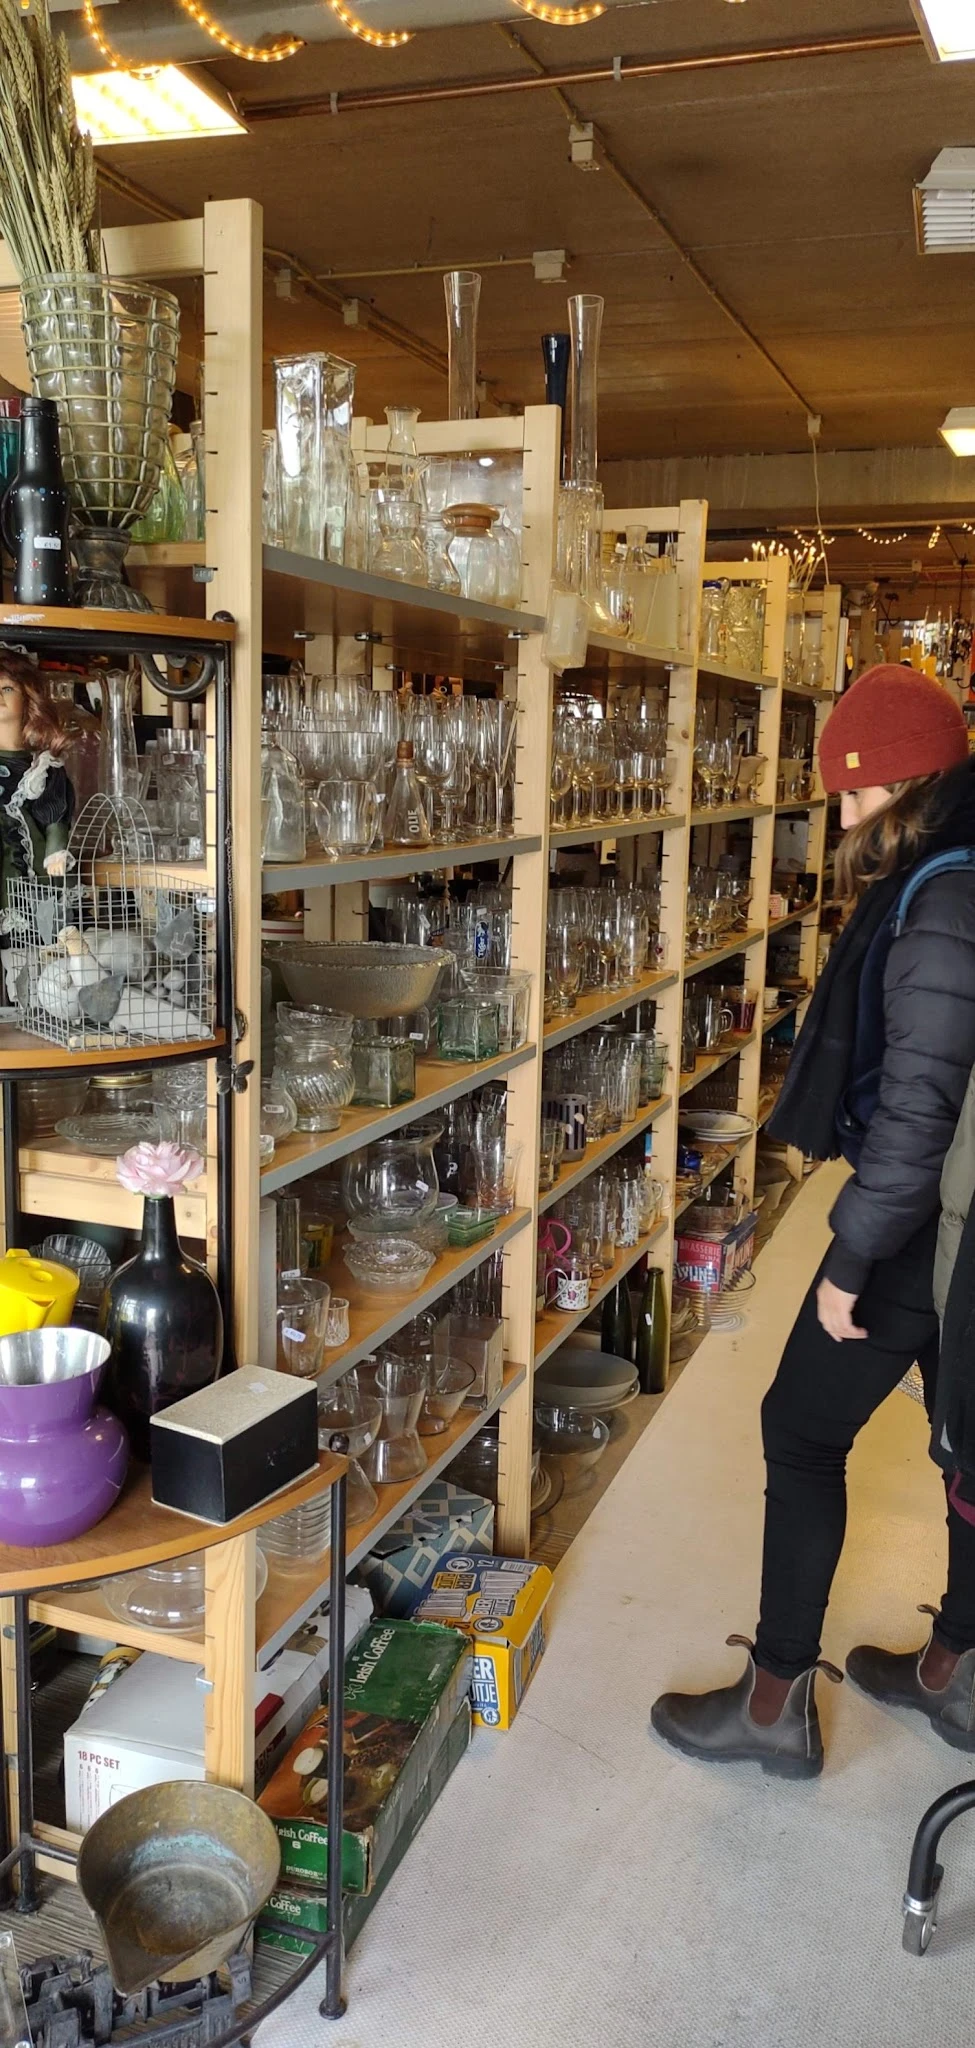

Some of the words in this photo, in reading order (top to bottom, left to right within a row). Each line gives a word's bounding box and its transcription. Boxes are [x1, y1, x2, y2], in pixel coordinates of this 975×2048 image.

[407, 809, 420, 833] OLIE
[680, 1240, 721, 1257] BRASSERIE
[363, 1628, 396, 1660] Coffee
[349, 1661, 378, 1684] Irish
[474, 1657, 494, 1680] ER
[78, 1750, 88, 1761] 18
[90, 1752, 102, 1765] PC
[104, 1756, 120, 1770] SET
[298, 1828, 328, 1846] Coffee
[270, 1897, 301, 1915] Coffee
